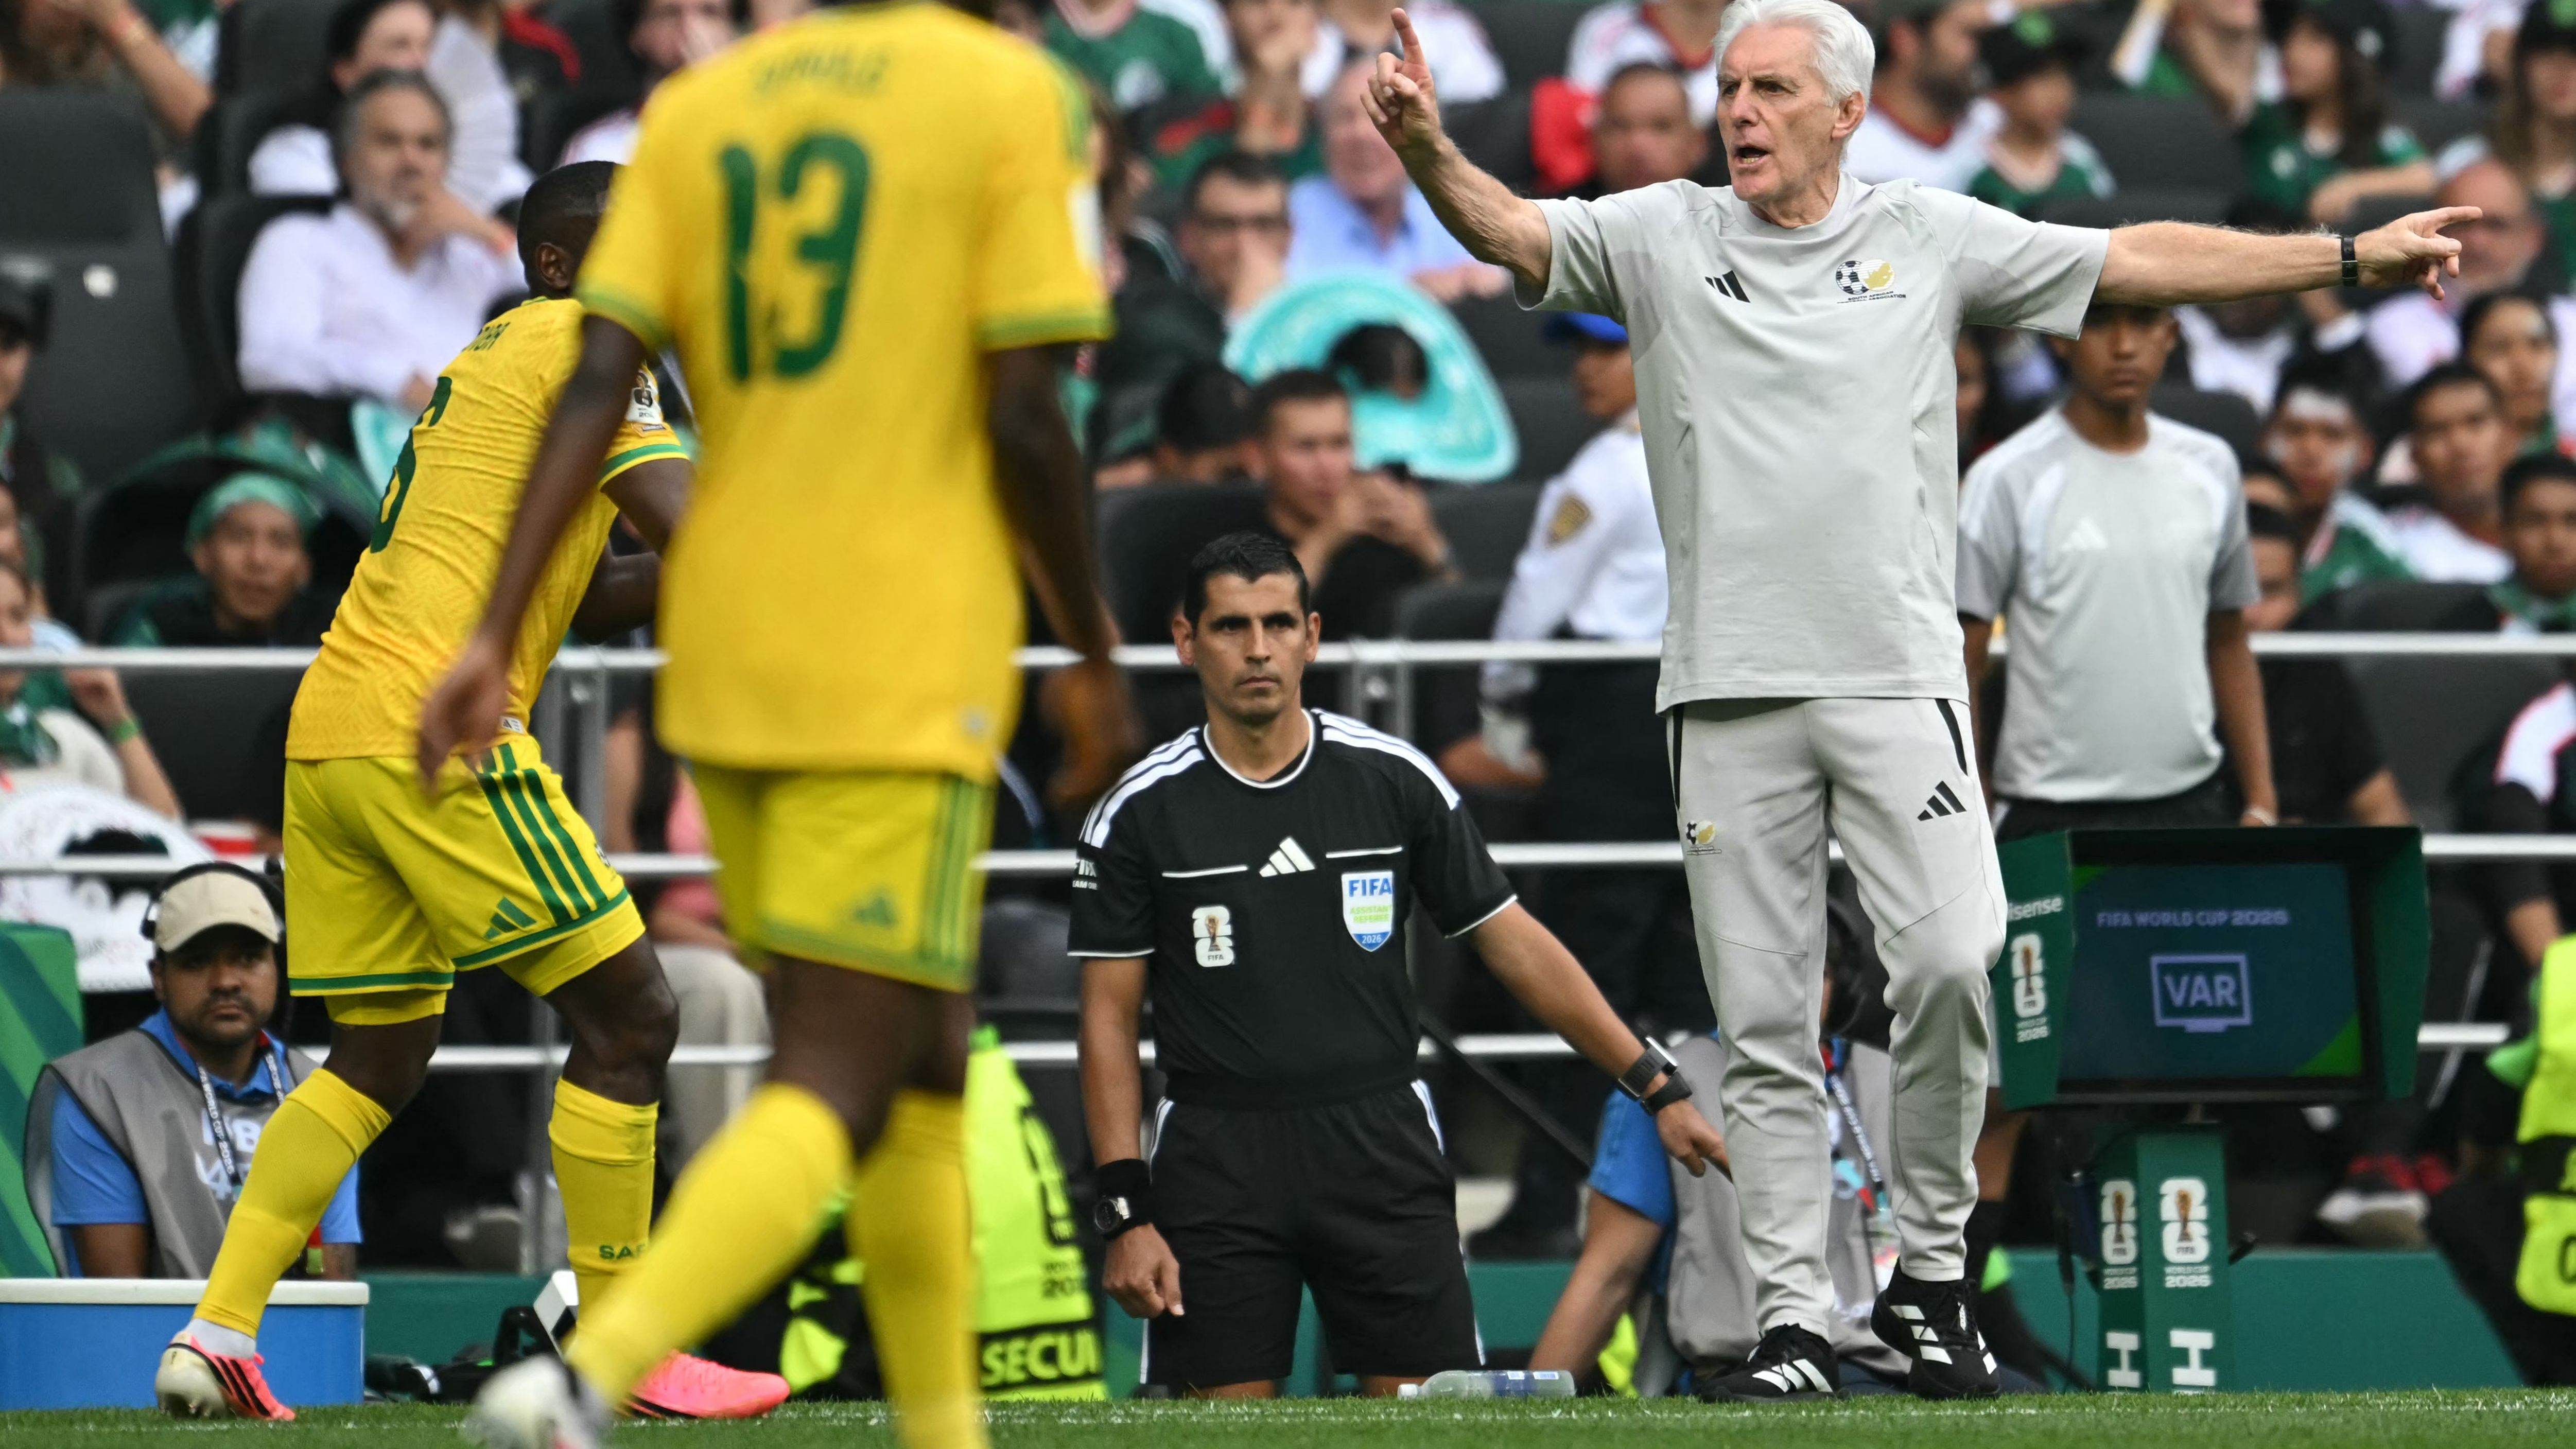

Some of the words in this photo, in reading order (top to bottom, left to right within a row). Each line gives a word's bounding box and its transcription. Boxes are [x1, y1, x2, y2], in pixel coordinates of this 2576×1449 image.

[718, 130, 870, 383] 13
[1348, 878, 1394, 897] FIFA
[1353, 914, 1389, 923] REFEREE
[2008, 897, 2063, 921] isense
[2097, 911, 2132, 927] FIFA
[2135, 910, 2194, 927] WORLD
[2196, 910, 2228, 927] CUP
[2231, 908, 2289, 926] 2026
[1362, 934, 1382, 944] 2026
[2163, 974, 2238, 1007] VAR
[203, 1083, 218, 1119] WORLD
[213, 1120, 224, 1140] CUP
[218, 1141, 235, 1175] 2026
[2103, 1275, 2138, 1289] 2026
[2165, 1274, 2212, 1288] 2026
